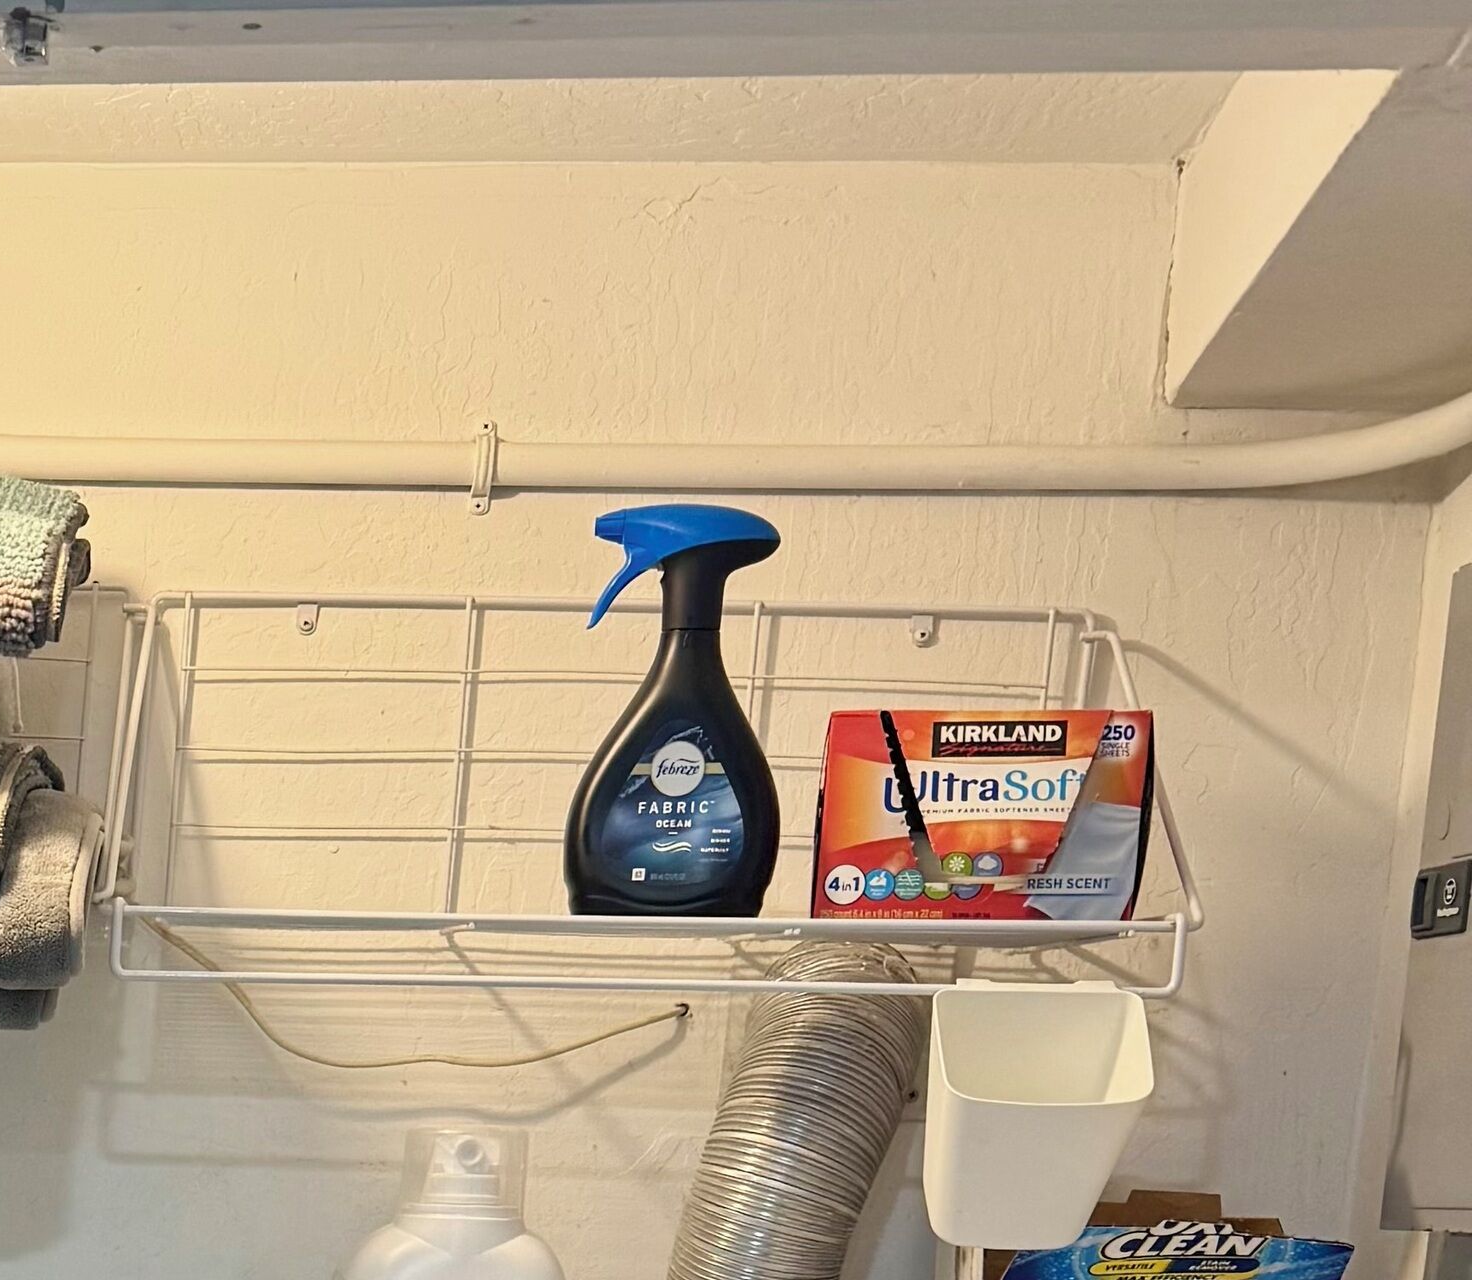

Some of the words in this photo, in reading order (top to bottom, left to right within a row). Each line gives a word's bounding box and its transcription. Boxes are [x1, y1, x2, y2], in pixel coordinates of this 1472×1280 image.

[940, 724, 1063, 743] KIRKLAND
[1102, 724, 1135, 740] 250
[940, 743, 1054, 756] Signature
[656, 758, 700, 778] febreze
[885, 769, 1086, 813] UltraSof
[638, 801, 709, 814] FABRIC
[656, 820, 692, 828] OCEAN
[1066, 878, 1111, 889] SCENT
[1104, 1230, 1270, 1259] CLEAN
